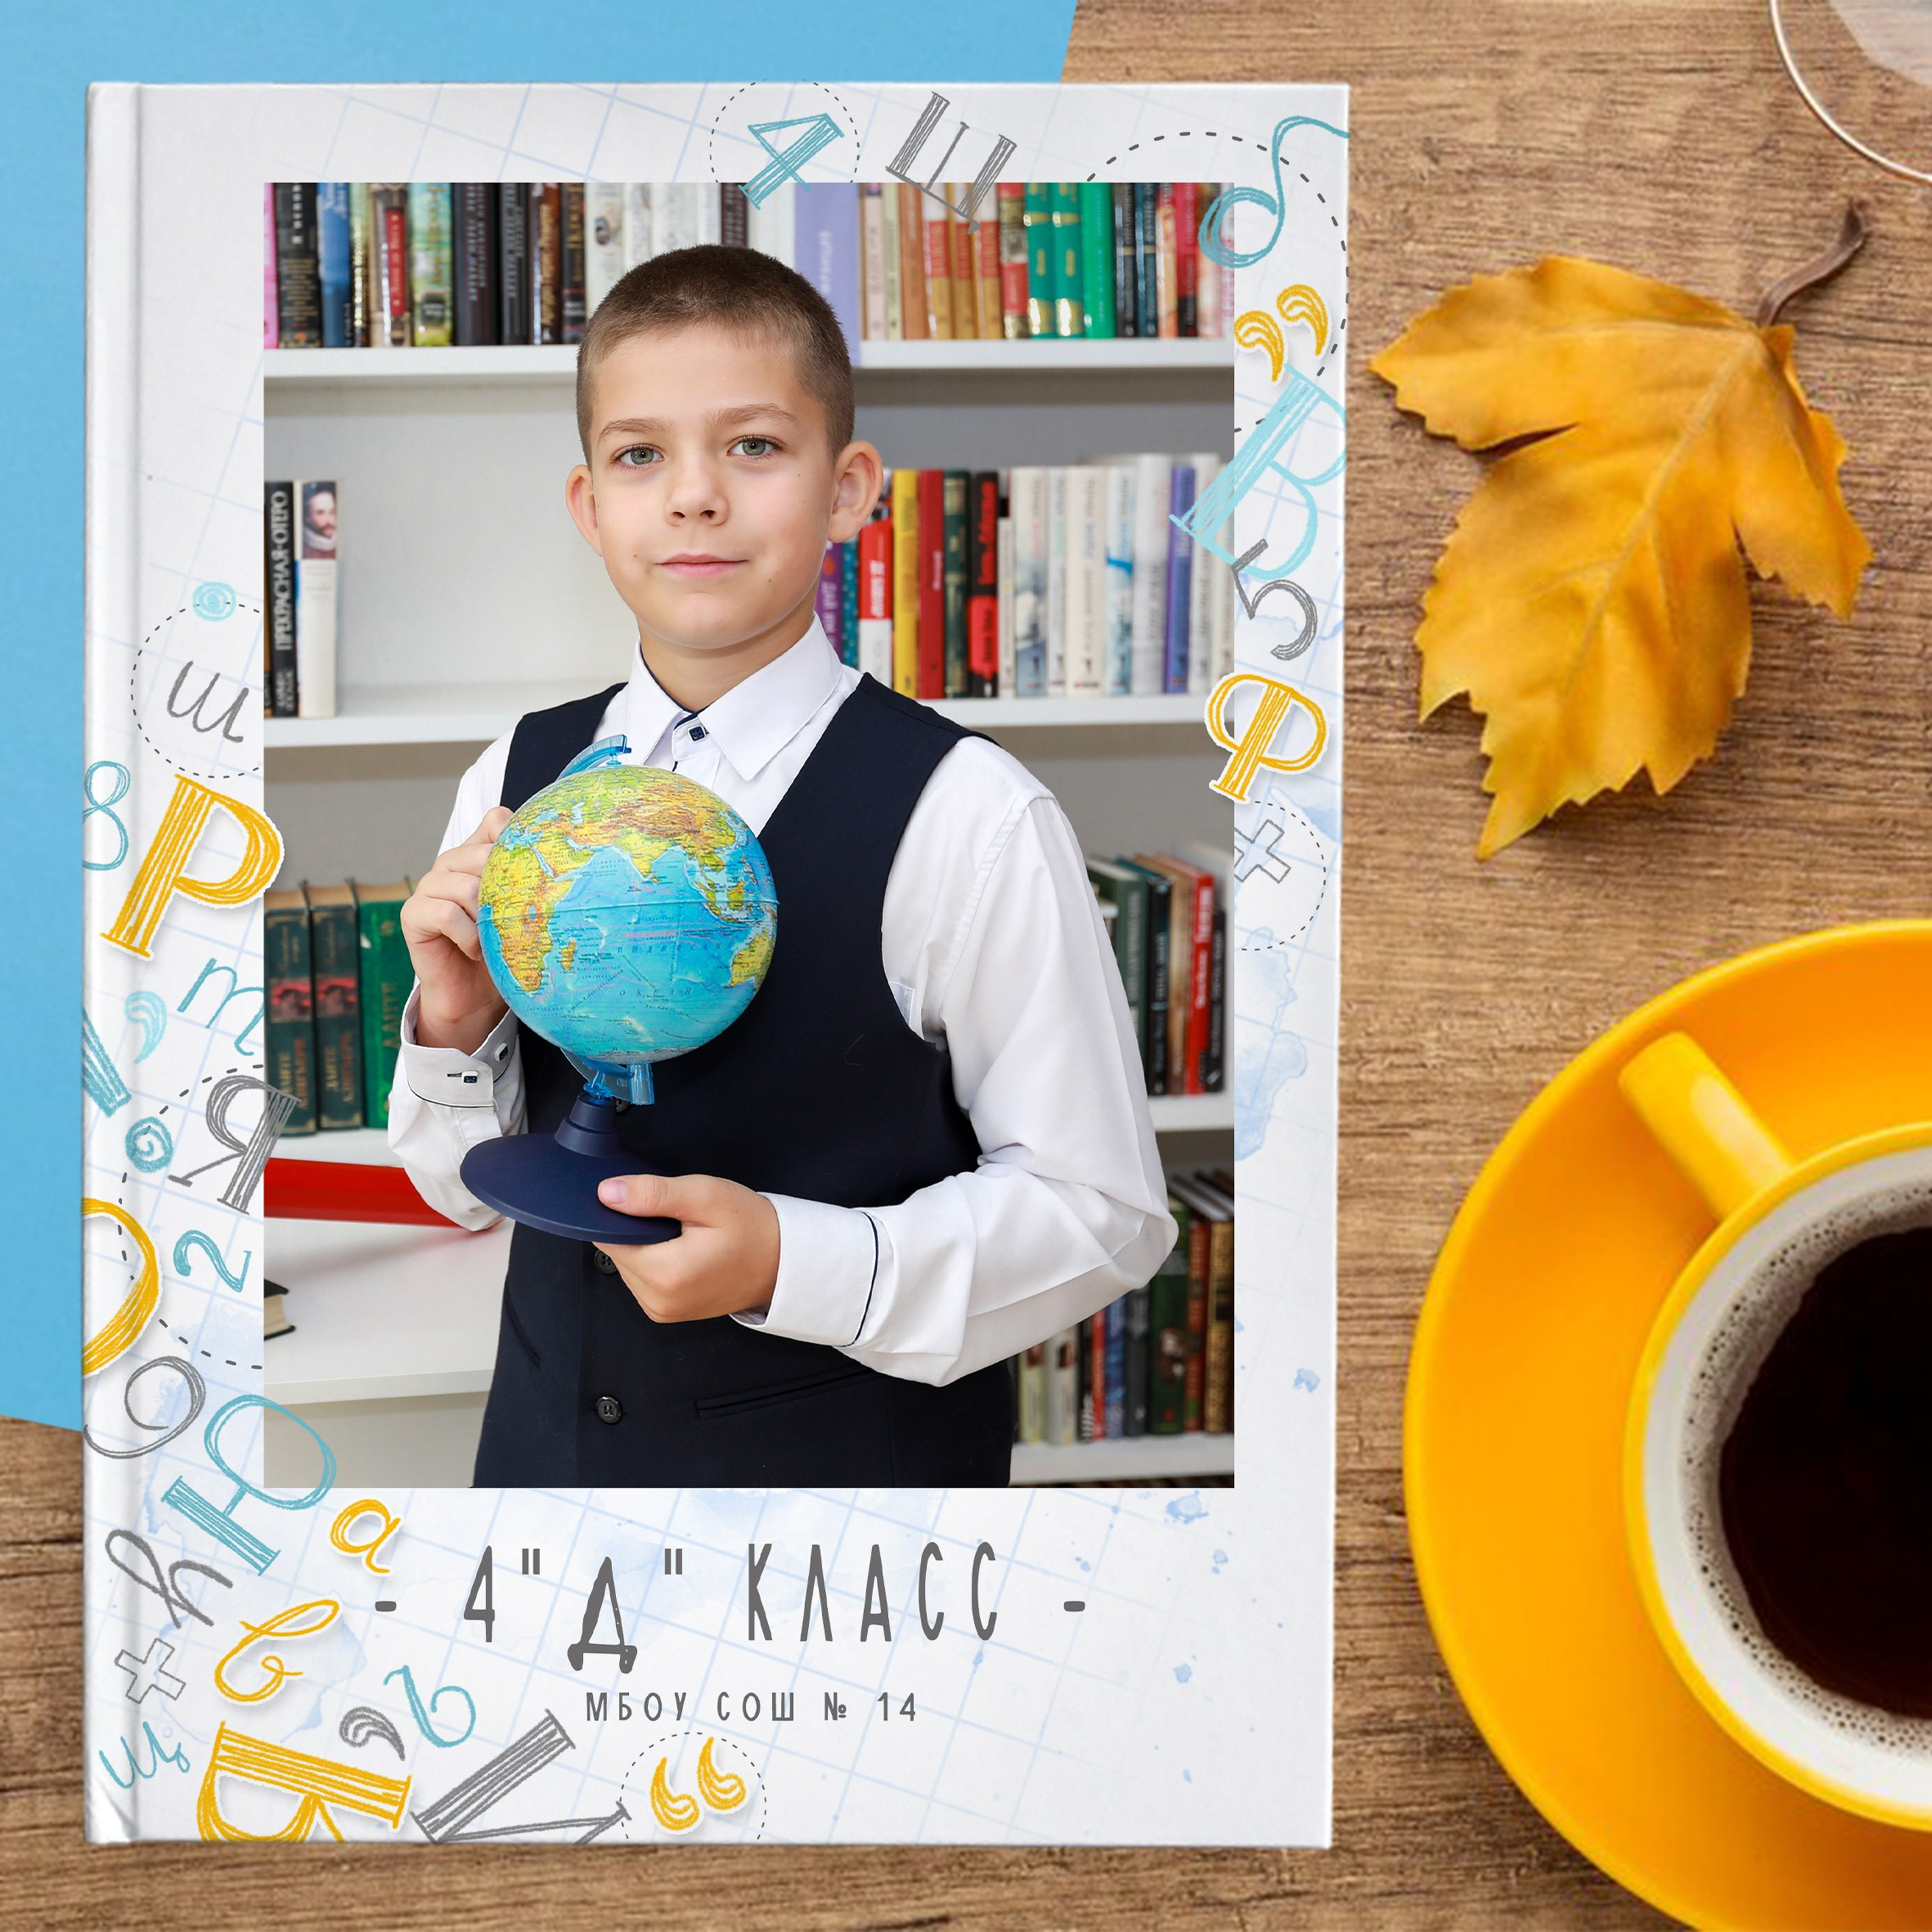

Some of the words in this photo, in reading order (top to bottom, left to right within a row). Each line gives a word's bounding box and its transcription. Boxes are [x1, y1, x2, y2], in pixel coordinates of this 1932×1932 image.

[168, 1075, 302, 1215] Я
[748, 1541, 999, 1642] КЛАСС
[586, 1691, 688, 1723] МБОУ
[717, 1691, 795, 1723] СОШ
[824, 1691, 848, 1723] №
[877, 1691, 917, 1723] 14
